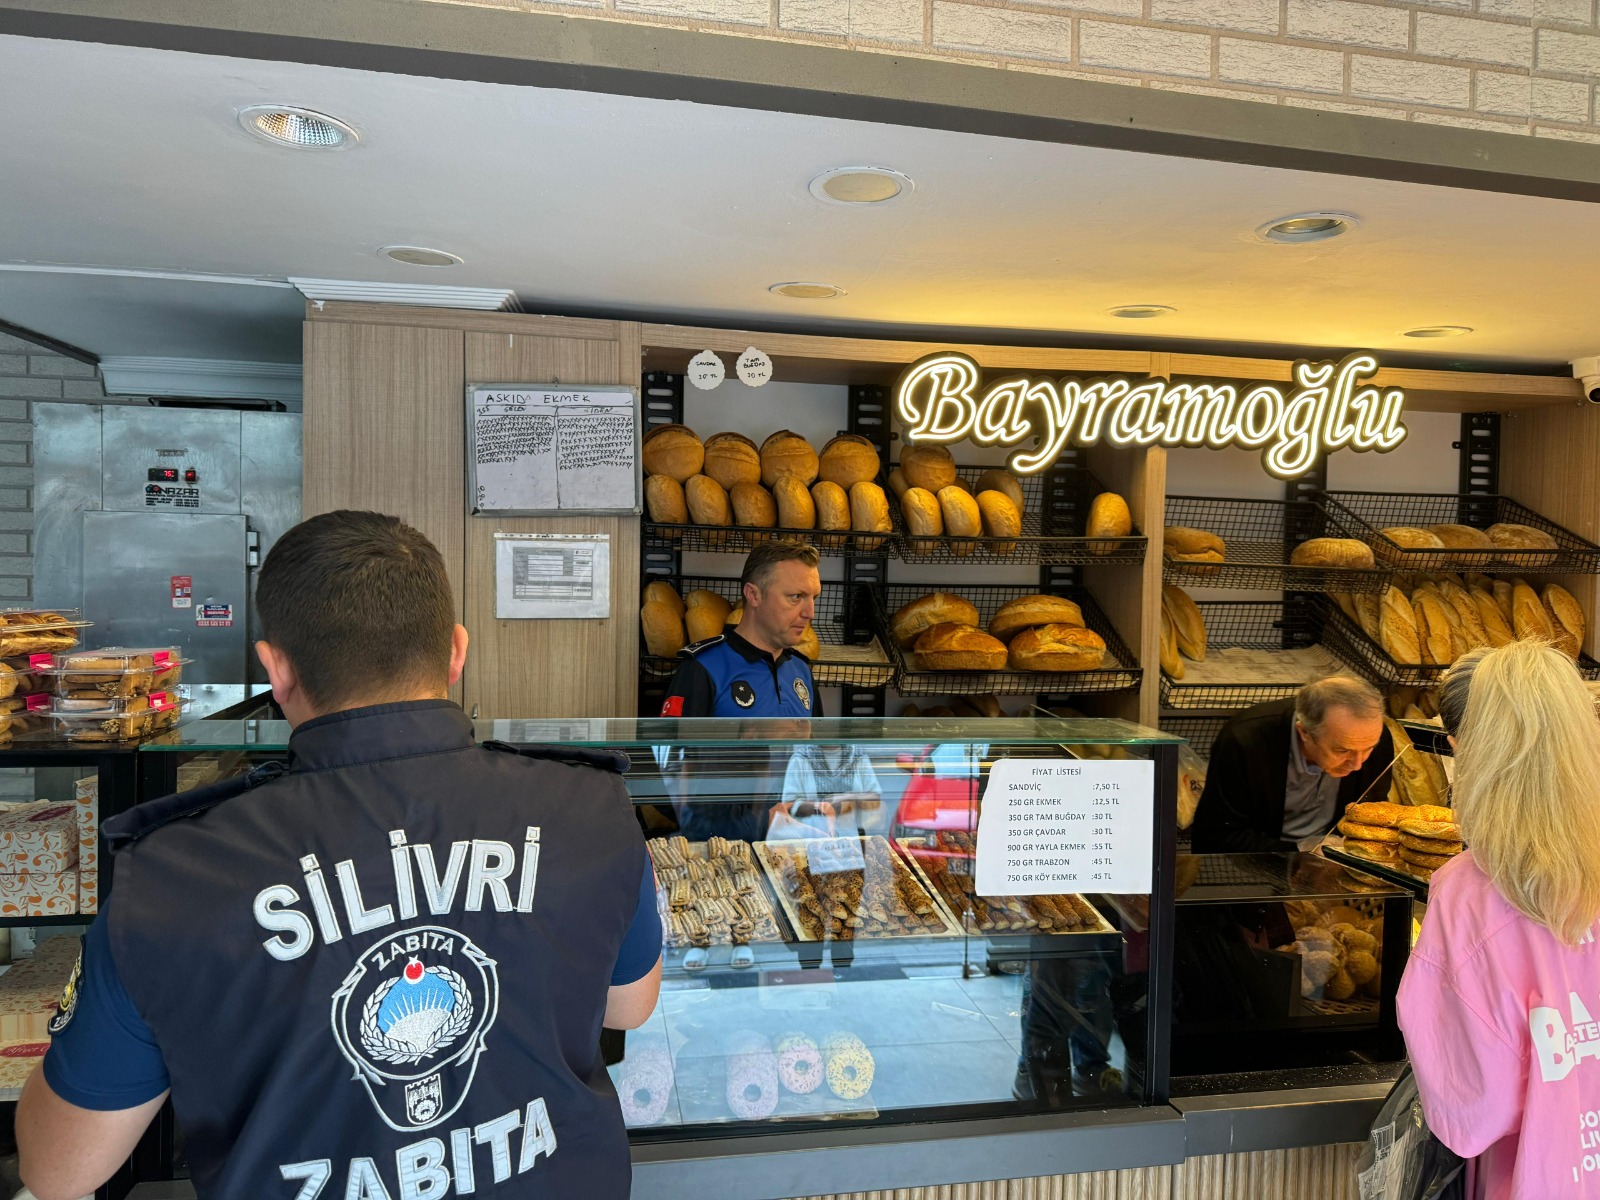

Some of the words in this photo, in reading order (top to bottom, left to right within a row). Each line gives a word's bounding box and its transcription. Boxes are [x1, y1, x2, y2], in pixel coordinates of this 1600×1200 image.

[543, 394, 591, 403] EKMEK
[899, 354, 1406, 475] Bayramoğlu
[158, 487, 199, 495] NAZAR
[1056, 767, 1081, 775] LİSTESİ
[1009, 783, 1041, 791] SANDVİÇ
[1093, 783, 1110, 791] :7,50
[1055, 812, 1086, 820] BUĞDAY
[1035, 829, 1066, 837] ÇAVDAR
[252, 826, 541, 961] SİLİVRİ
[371, 931, 454, 971] ZABITA
[279, 1097, 557, 1200] ZABITA
